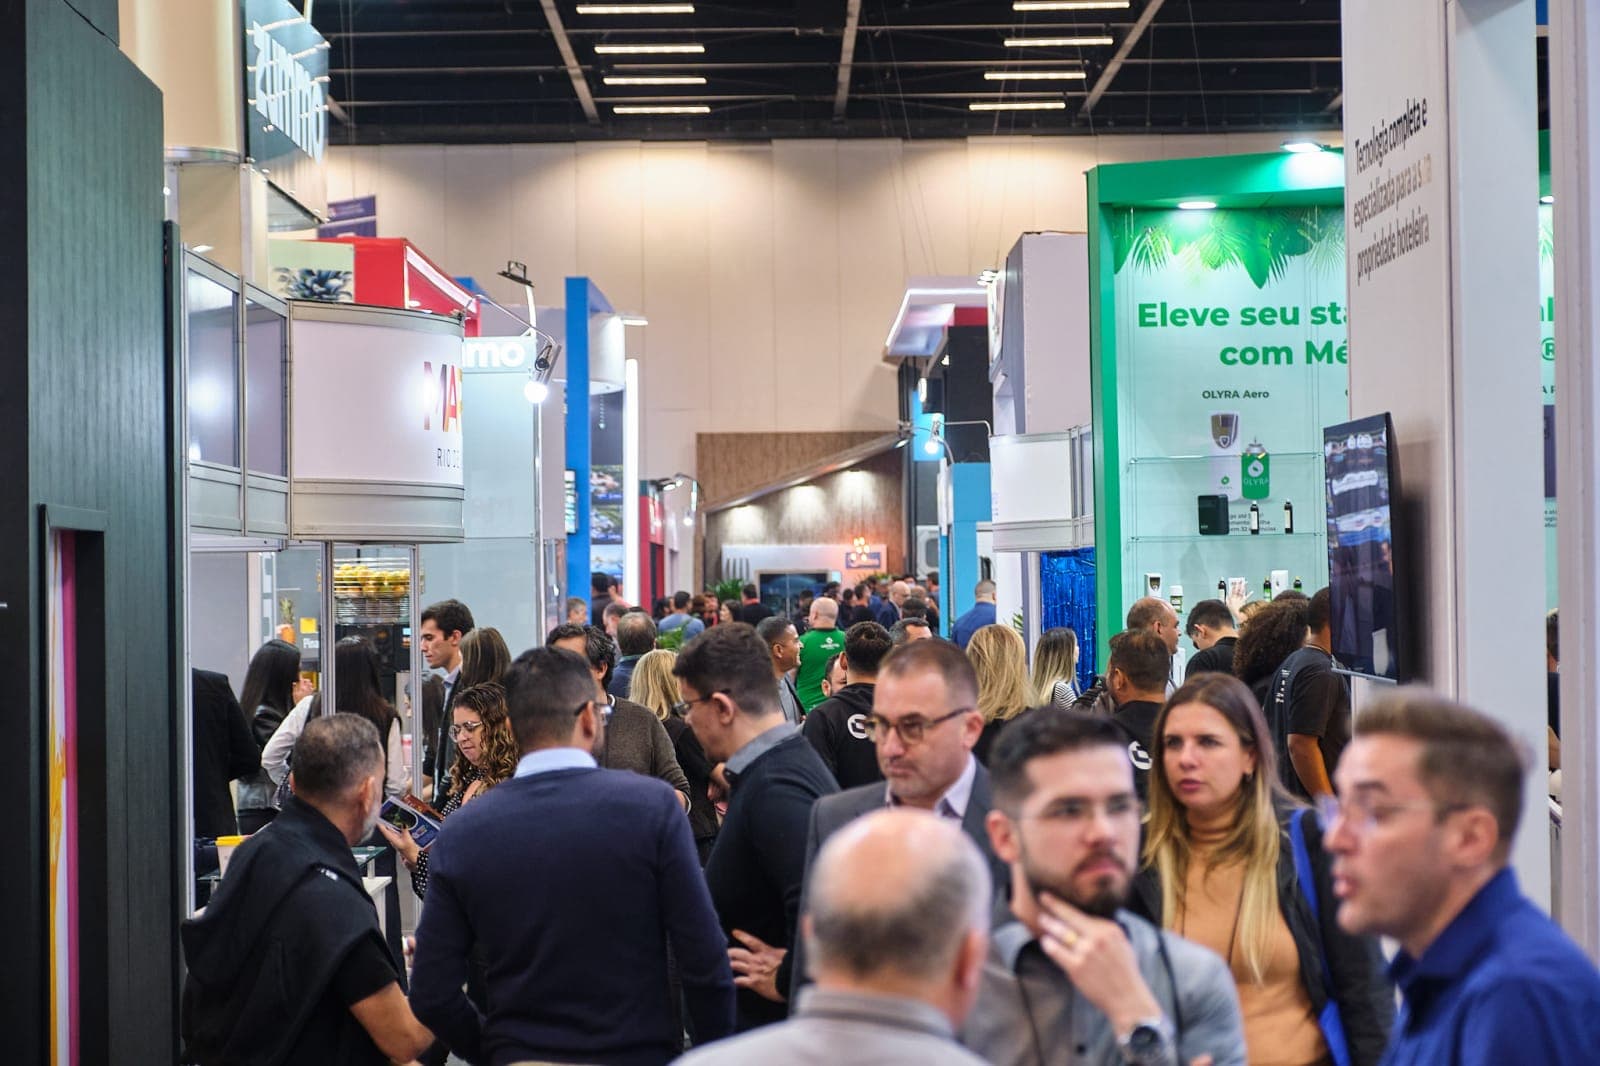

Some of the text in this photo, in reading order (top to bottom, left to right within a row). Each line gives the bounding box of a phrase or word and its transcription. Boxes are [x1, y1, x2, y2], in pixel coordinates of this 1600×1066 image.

[1355, 97, 1428, 176] Tecnologia completa e
[1354, 168, 1395, 232] especializada
[1395, 165, 1411, 211] para
[1411, 162, 1417, 192] a
[1356, 204, 1430, 286] propriedade hoteleira
[1138, 302, 1230, 327] Eleve
[1240, 305, 1300, 326] seu
[462, 341, 526, 368] mo
[1219, 345, 1294, 366] com
[1202, 389, 1270, 400] OLYRA Aero
